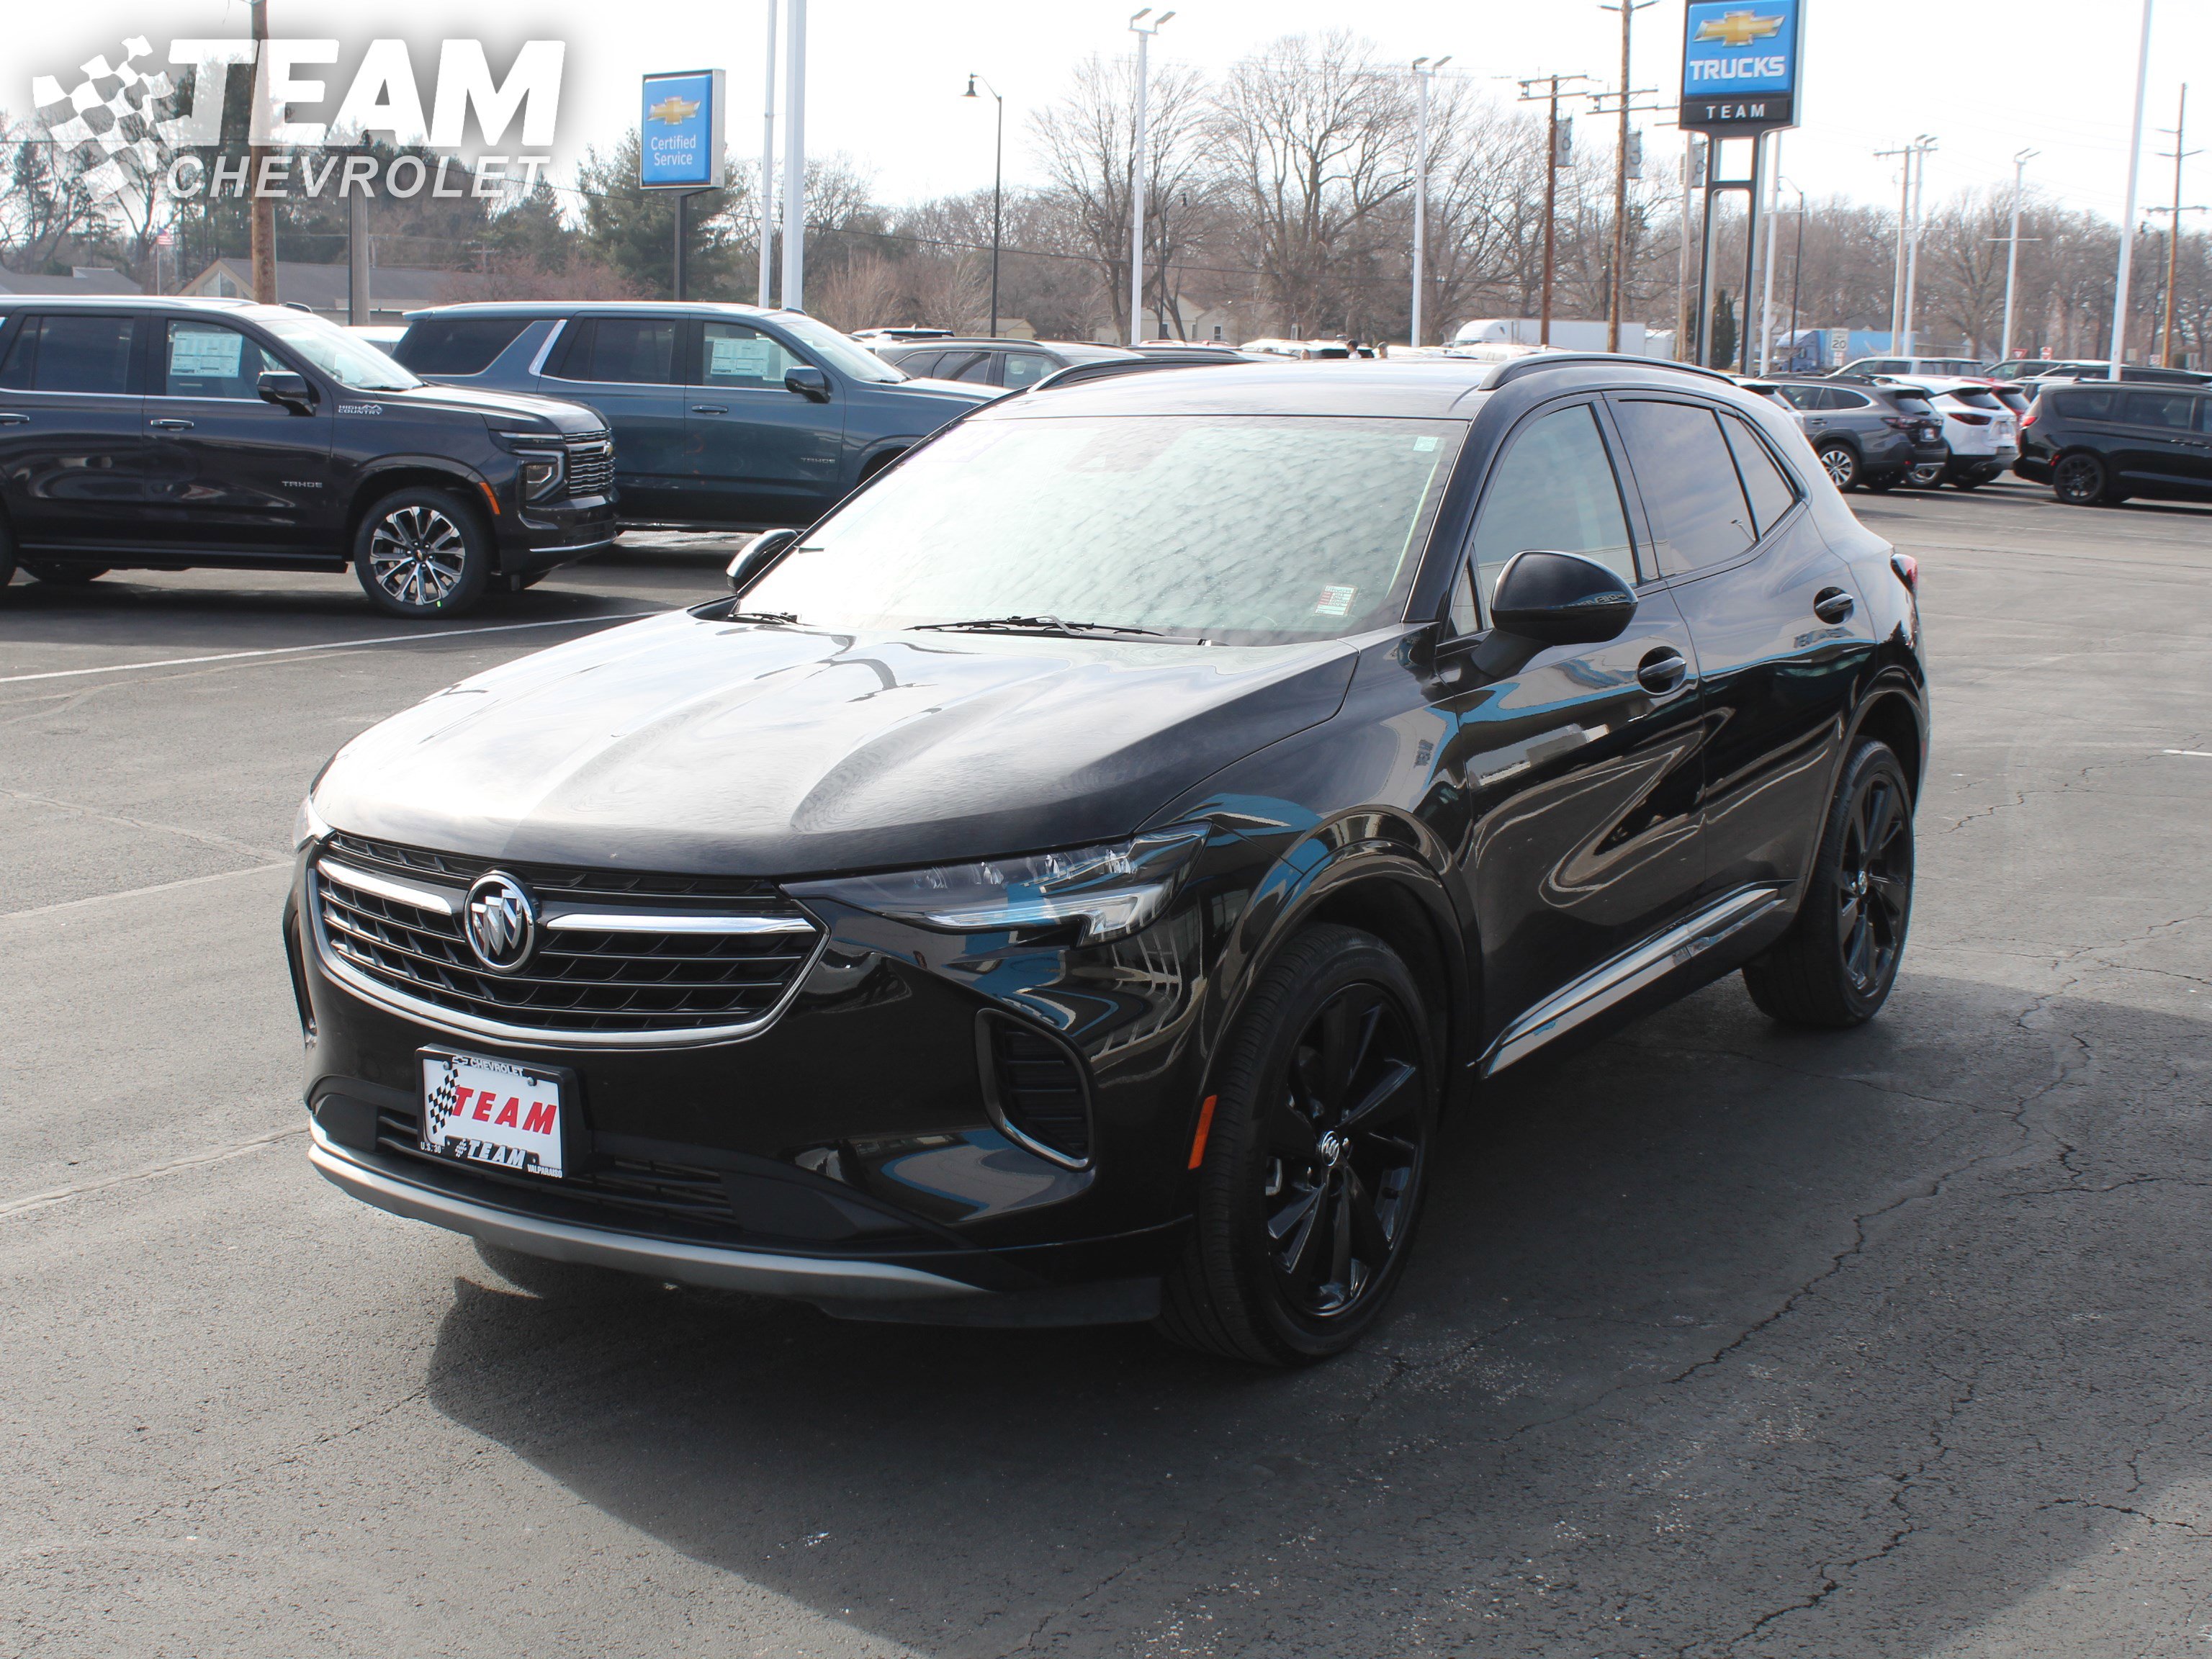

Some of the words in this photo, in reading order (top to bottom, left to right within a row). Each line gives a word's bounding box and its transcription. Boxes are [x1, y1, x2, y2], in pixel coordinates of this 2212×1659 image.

[1689, 55, 1786, 81] TRUCKS
[1706, 103, 1766, 120] TEAM
[650, 134, 696, 150] Certified
[654, 152, 693, 166] Service
[1832, 339, 1847, 349] 20
[469, 1058, 525, 1077] CHEVROLET
[451, 1085, 557, 1136] TEAM
[467, 1138, 527, 1167] TEAM
[527, 1164, 563, 1179] VALPARAISO
